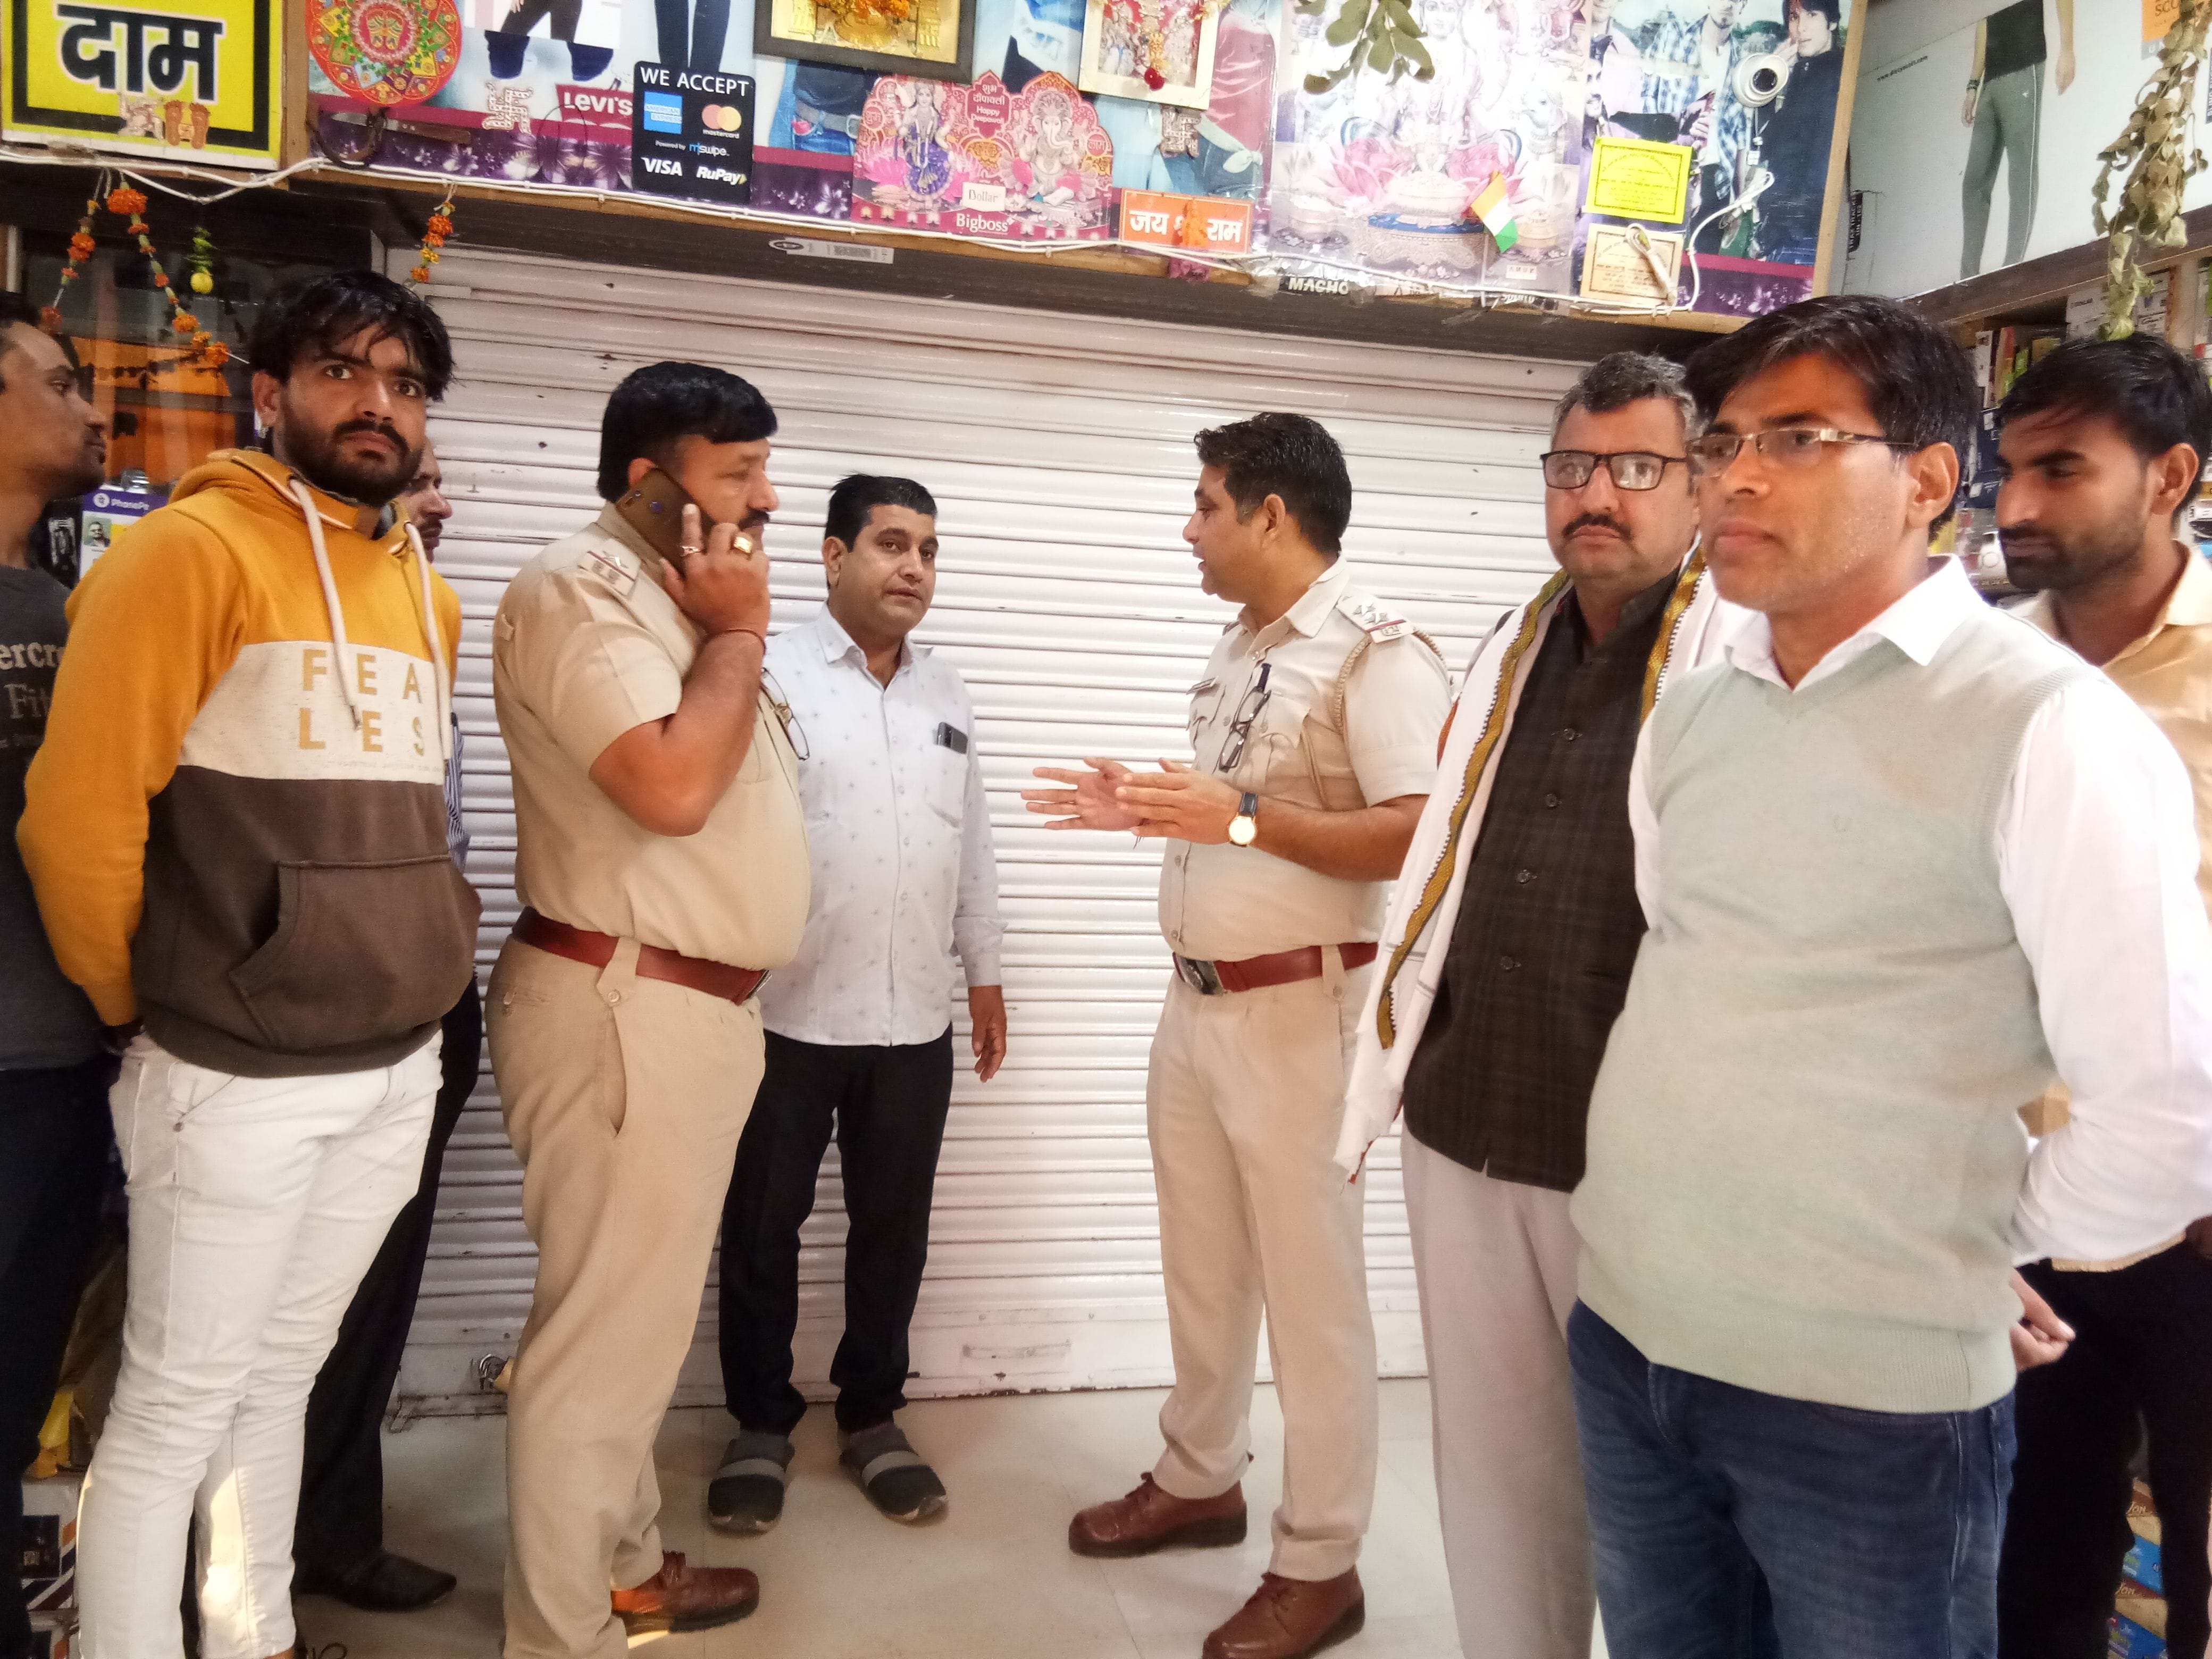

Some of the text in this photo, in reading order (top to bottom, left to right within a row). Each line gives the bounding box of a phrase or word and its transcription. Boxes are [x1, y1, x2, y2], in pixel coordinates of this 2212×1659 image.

[57, 4, 224, 102] दाम
[640, 66, 750, 97] WE ACCEPT
[641, 157, 683, 176] VISA
[696, 165, 741, 185] RuPay
[968, 189, 999, 203] Dollar
[956, 213, 1009, 232] Bigboss
[1129, 210, 1169, 235] जय
[1206, 218, 1243, 242] राम
[1288, 277, 1350, 296] MACHO
